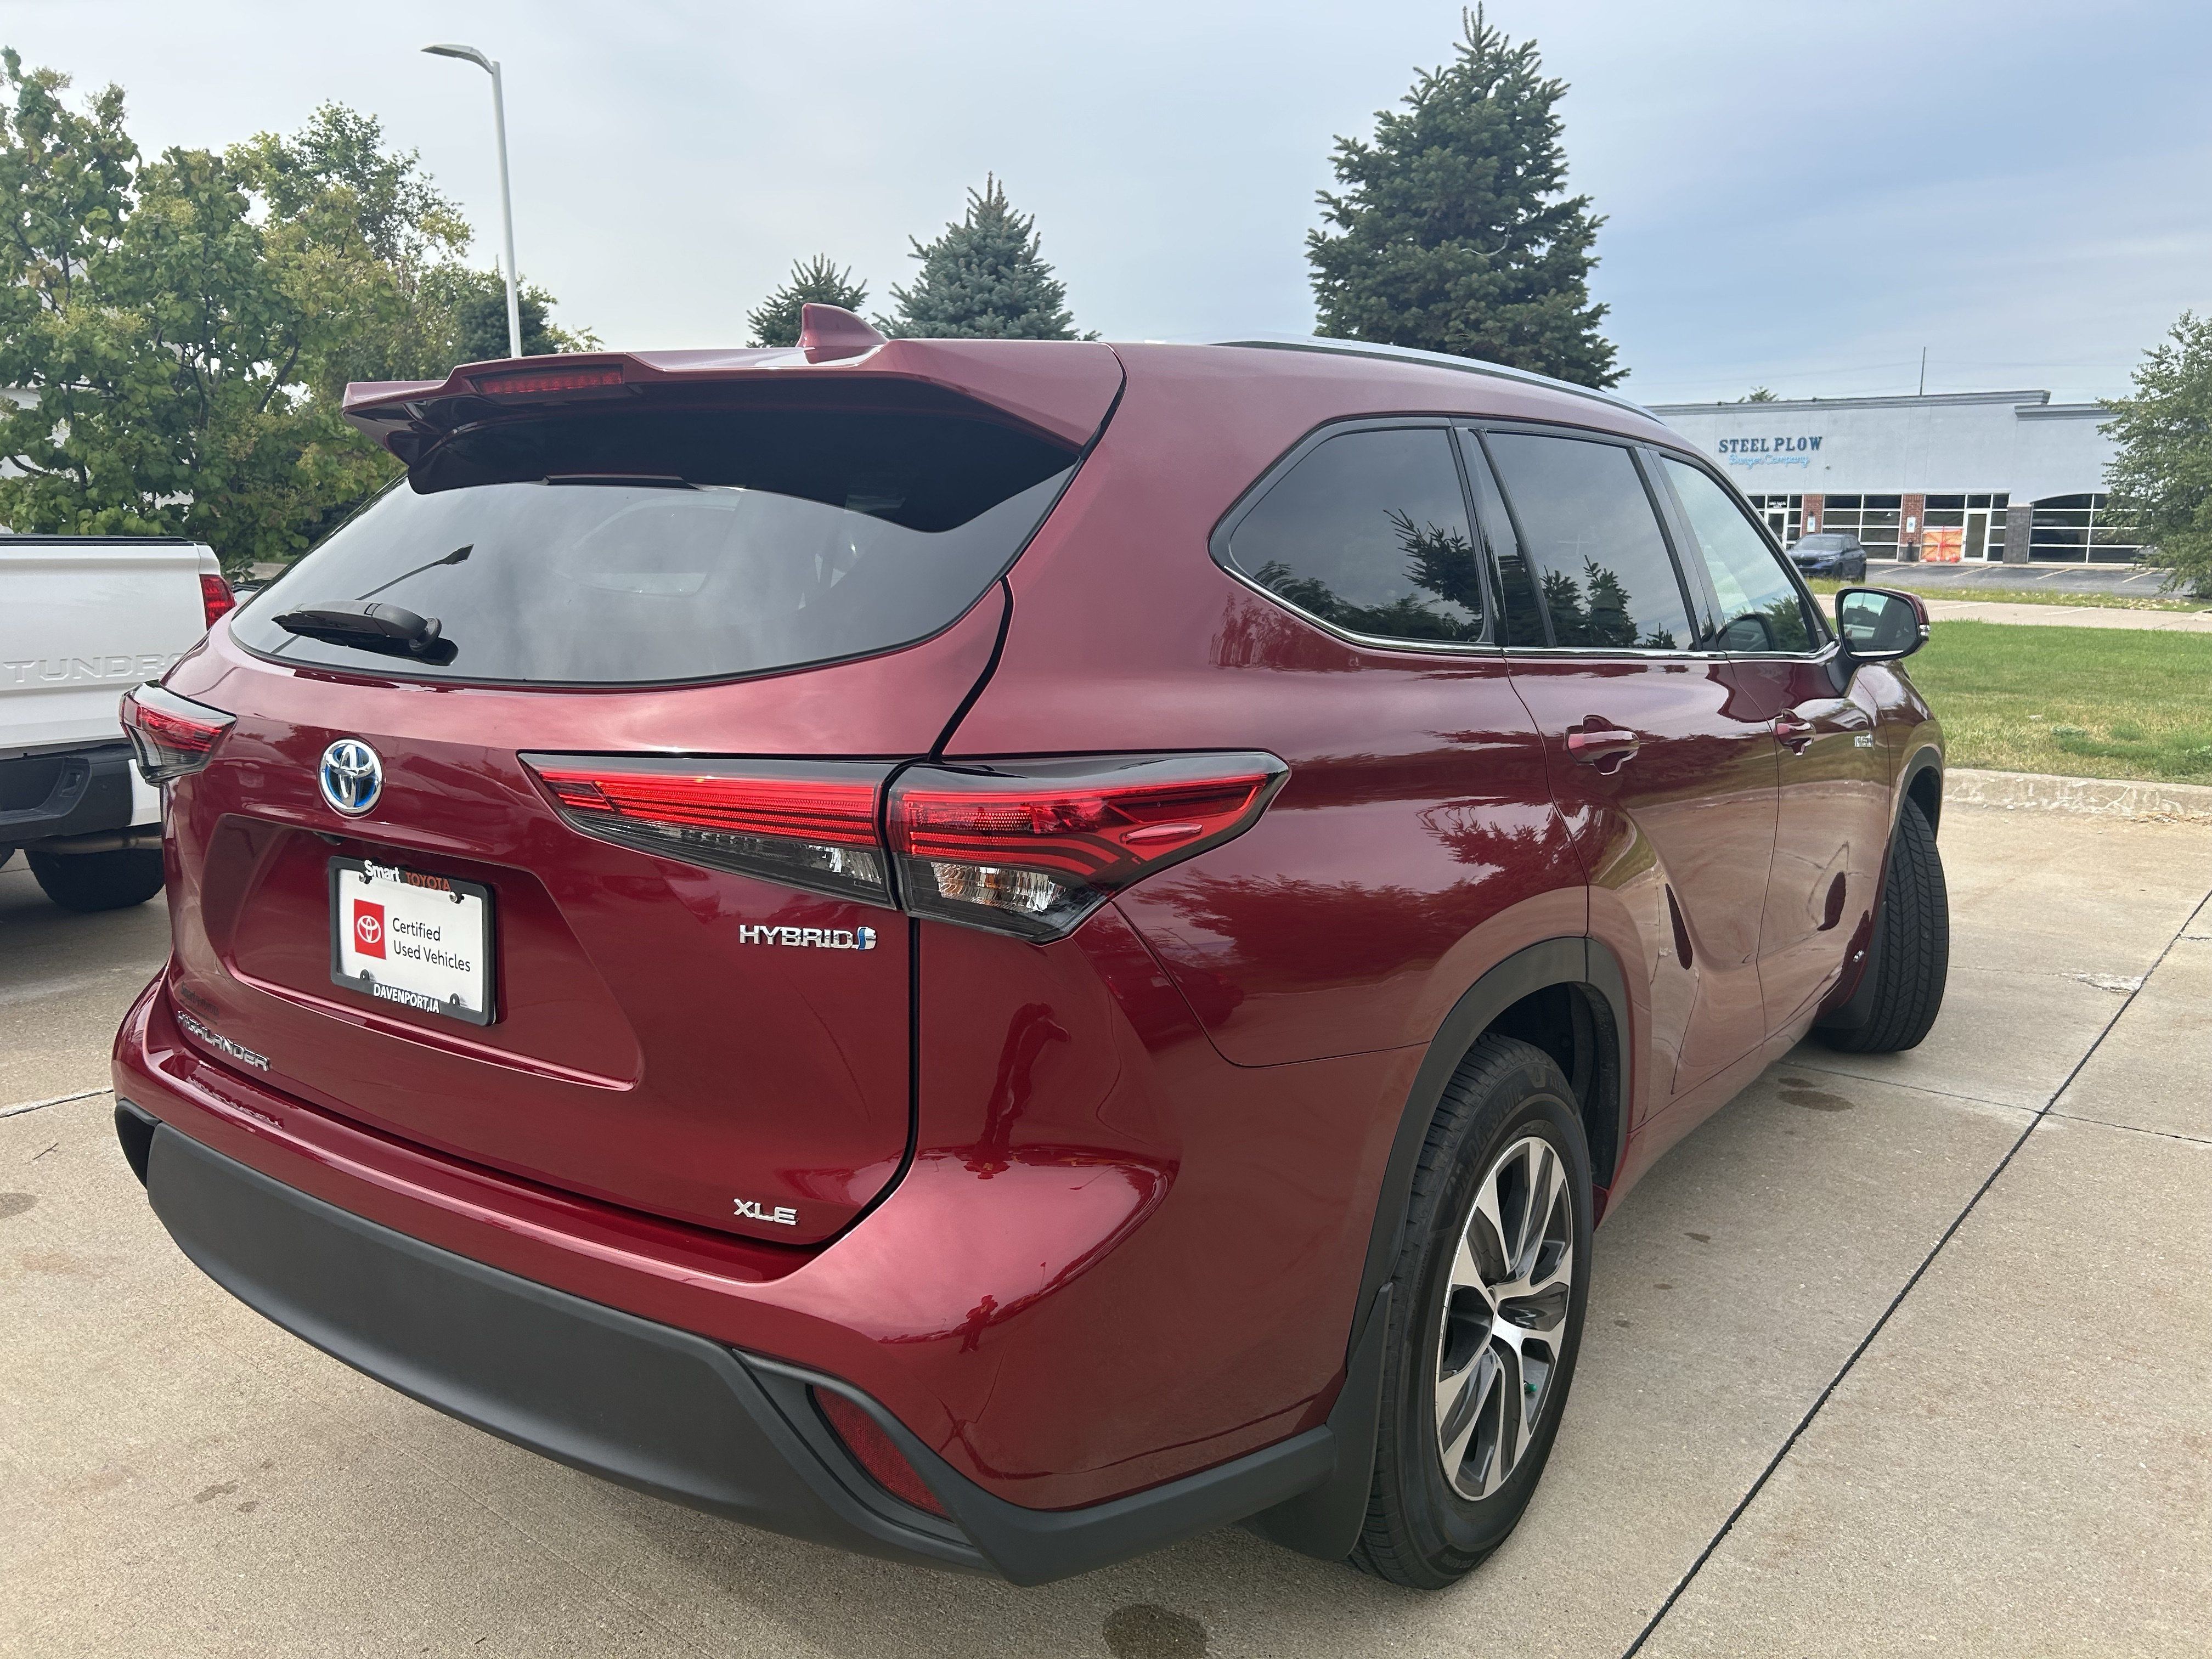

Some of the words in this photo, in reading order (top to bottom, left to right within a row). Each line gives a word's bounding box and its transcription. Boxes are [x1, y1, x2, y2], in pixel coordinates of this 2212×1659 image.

[1719, 438, 1769, 453] STEEL
[1774, 436, 1822, 452] PLOW
[1729, 453, 1763, 470] Burger
[1764, 453, 1810, 469] Company
[364, 860, 401, 883] Smart
[405, 871, 452, 892] TOYOTA
[392, 917, 441, 941] Certified
[740, 924, 853, 950] HYBRID
[393, 940, 421, 960] Used
[423, 946, 471, 972] Vehicles
[733, 1198, 798, 1226] XLE
